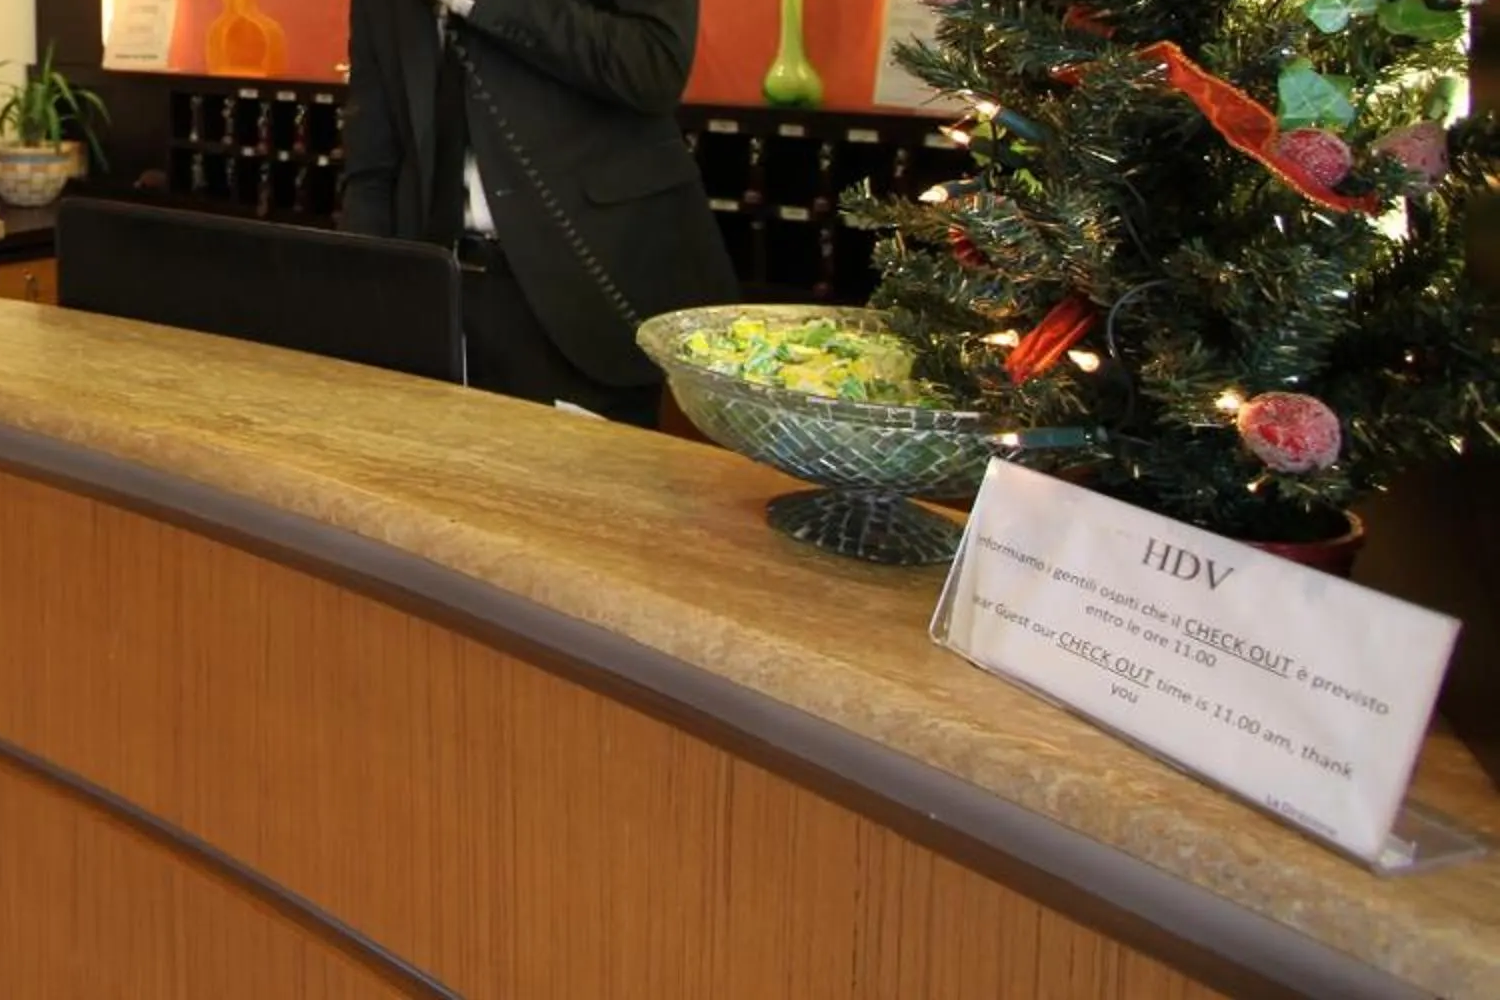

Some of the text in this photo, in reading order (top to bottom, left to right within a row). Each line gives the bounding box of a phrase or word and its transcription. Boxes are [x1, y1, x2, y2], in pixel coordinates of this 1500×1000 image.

[1142, 536, 1236, 591] HDV
[1053, 566, 1098, 594] gentili
[1100, 585, 1139, 610] ospiti
[1141, 603, 1168, 623] che
[1171, 614, 1182, 630] il
[1184, 618, 1246, 658] CHECK
[1250, 644, 1295, 675] OUT
[1311, 674, 1390, 716] previsto
[1086, 603, 1218, 669] entro le ore 11.00
[995, 601, 1031, 630] Guest
[1032, 620, 1057, 641] our
[1058, 631, 1110, 665] CHECK
[1114, 656, 1156, 685] OUT
[1156, 676, 1193, 703] time
[1195, 698, 1208, 712] is
[1213, 702, 1262, 736] 11.00
[1262, 728, 1295, 755] am,
[1300, 745, 1355, 781] thank
[1111, 681, 1139, 706] you
